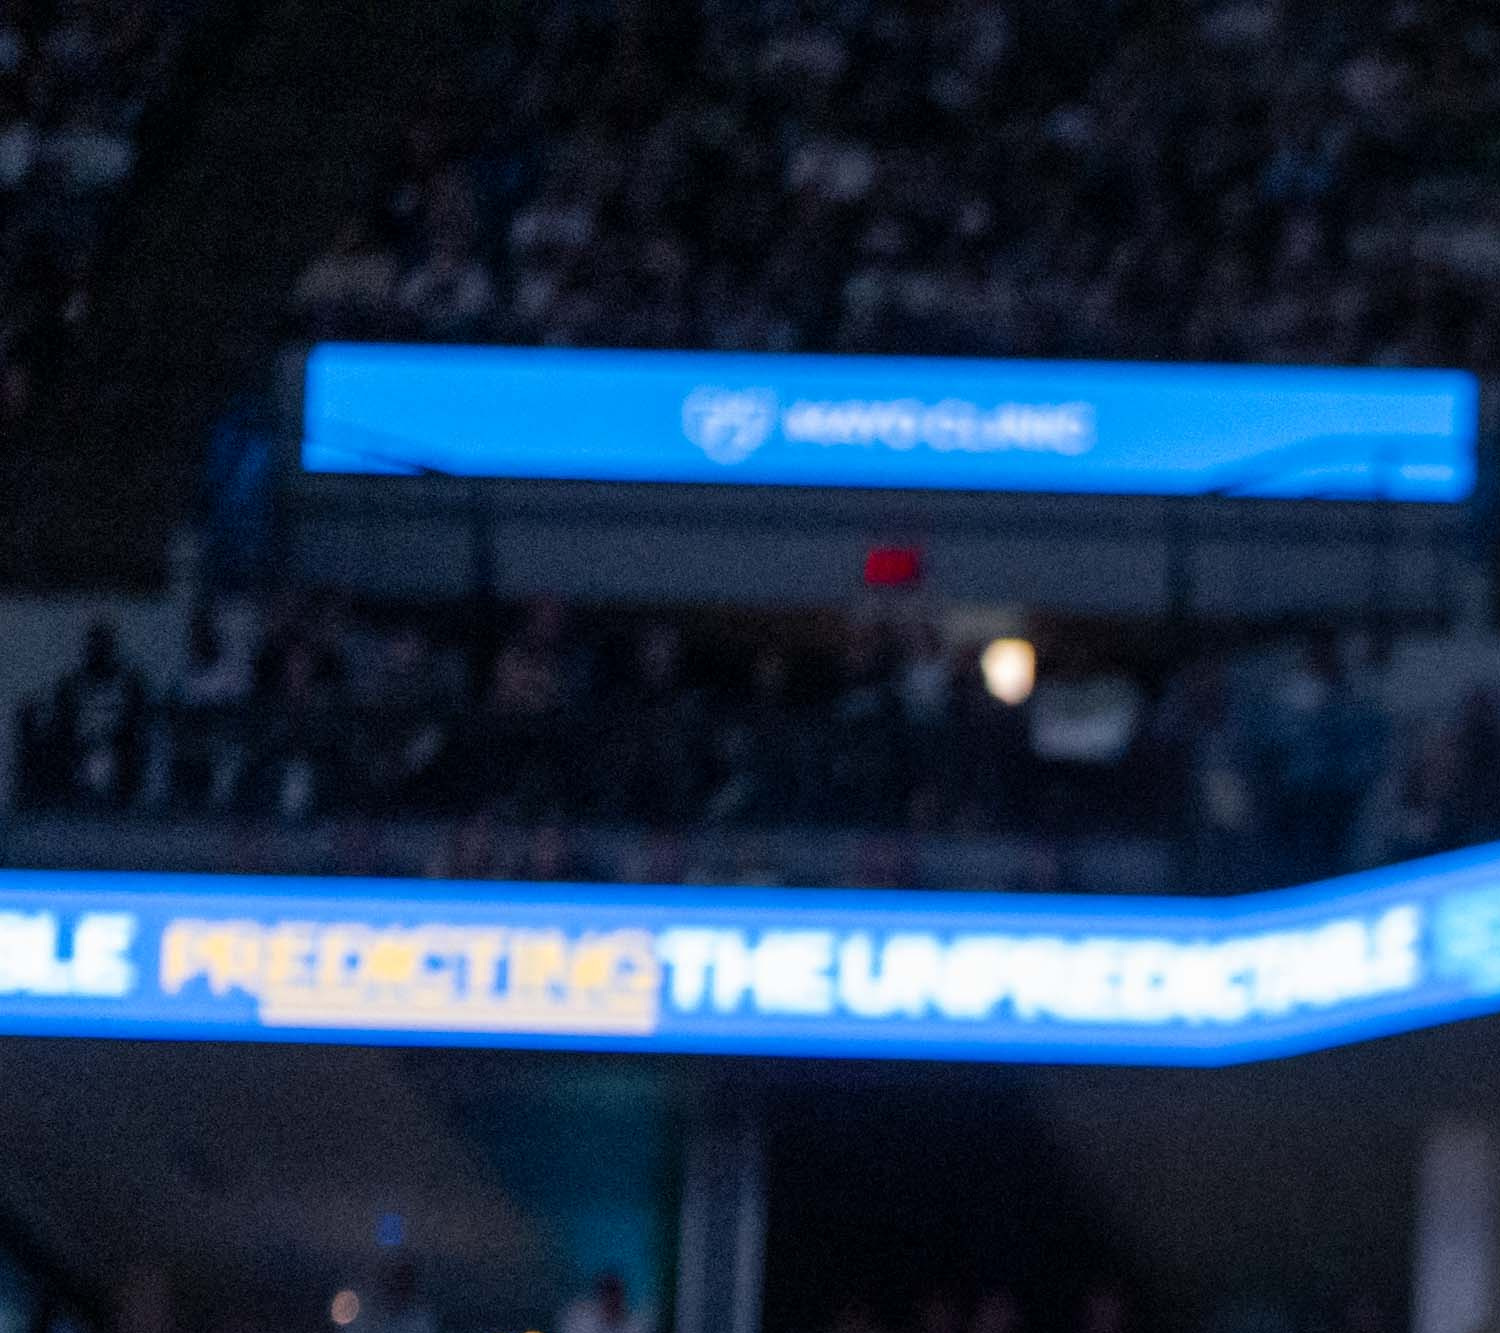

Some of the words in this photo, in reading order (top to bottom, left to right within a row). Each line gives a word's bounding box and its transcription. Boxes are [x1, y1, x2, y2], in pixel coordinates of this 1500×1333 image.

[159, 914, 656, 1000] PREDICTING
[659, 927, 835, 1014] THE
[839, 902, 1421, 1023] UNPREDICTABLE
